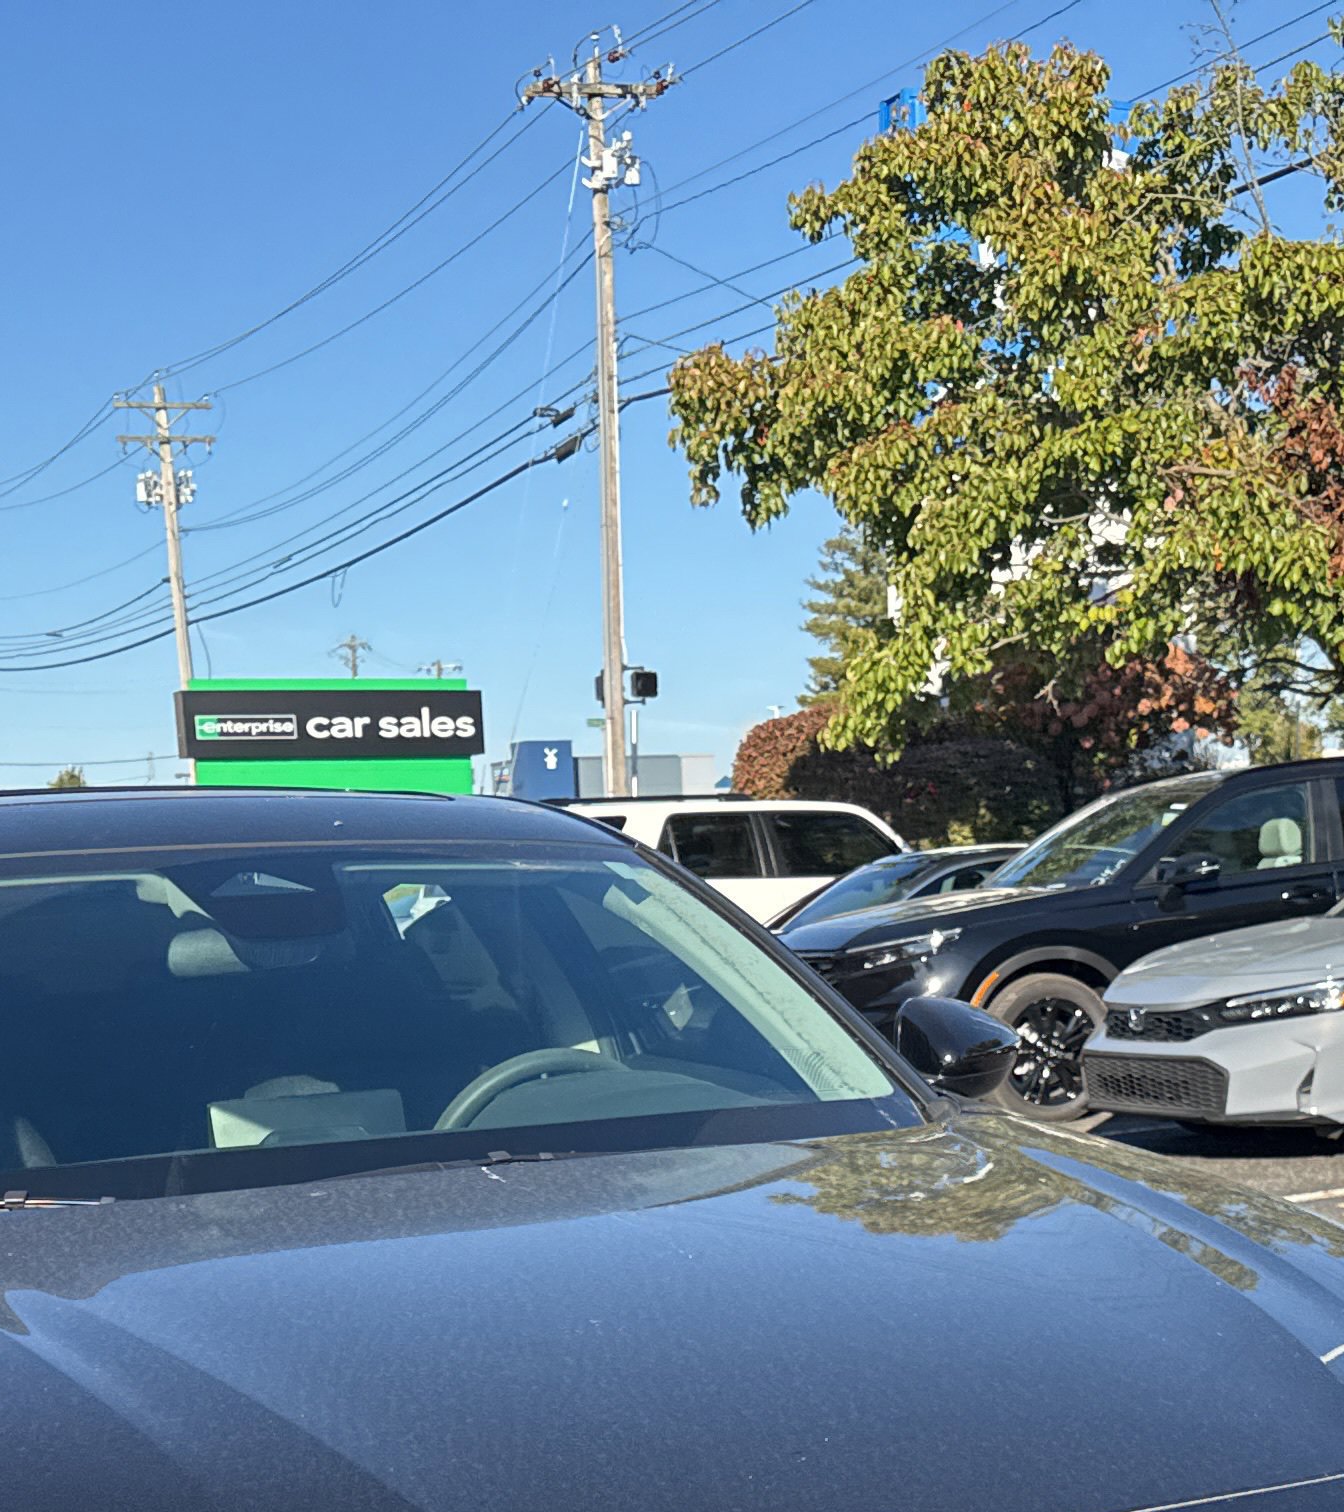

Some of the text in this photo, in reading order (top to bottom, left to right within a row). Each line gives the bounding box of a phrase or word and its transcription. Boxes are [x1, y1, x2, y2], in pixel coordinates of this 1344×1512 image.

[199, 705, 476, 739] enterprise car sales
